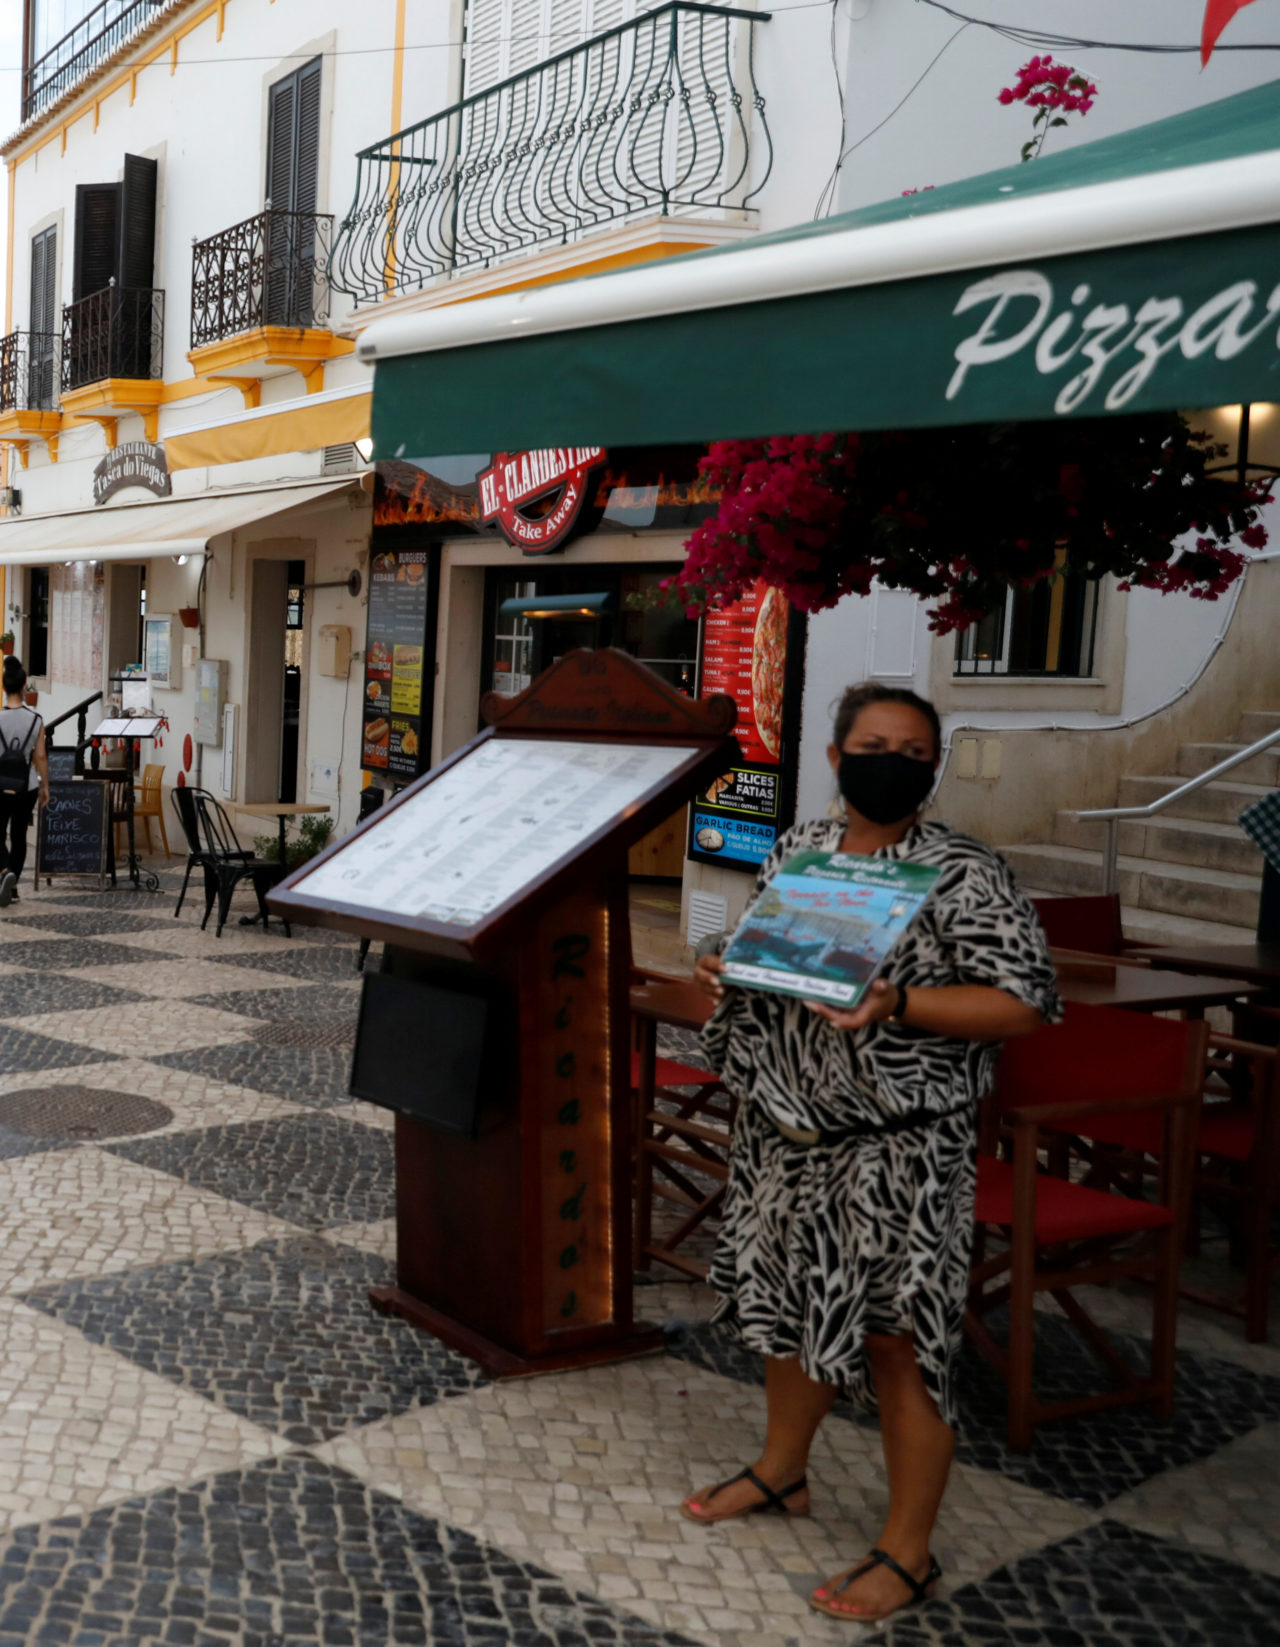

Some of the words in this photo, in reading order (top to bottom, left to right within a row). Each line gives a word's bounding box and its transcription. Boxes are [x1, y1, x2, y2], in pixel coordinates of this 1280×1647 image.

[96, 464, 122, 496] Tasca
[123, 456, 134, 476] do
[135, 455, 166, 488] Viegas
[480, 474, 500, 516] EL
[512, 515, 542, 540] Take
[546, 483, 577, 535] Away
[391, 720, 409, 731] FRIES
[736, 772, 774, 788] SLICES
[735, 784, 774, 799] FATIAS
[718, 800, 737, 808] VARIOUS
[740, 803, 759, 811] OUTRAS
[695, 816, 733, 831] GARLIC
[736, 823, 774, 838] BREAD
[47, 833, 100, 845] MARISCO
[742, 835, 751, 843] DE
